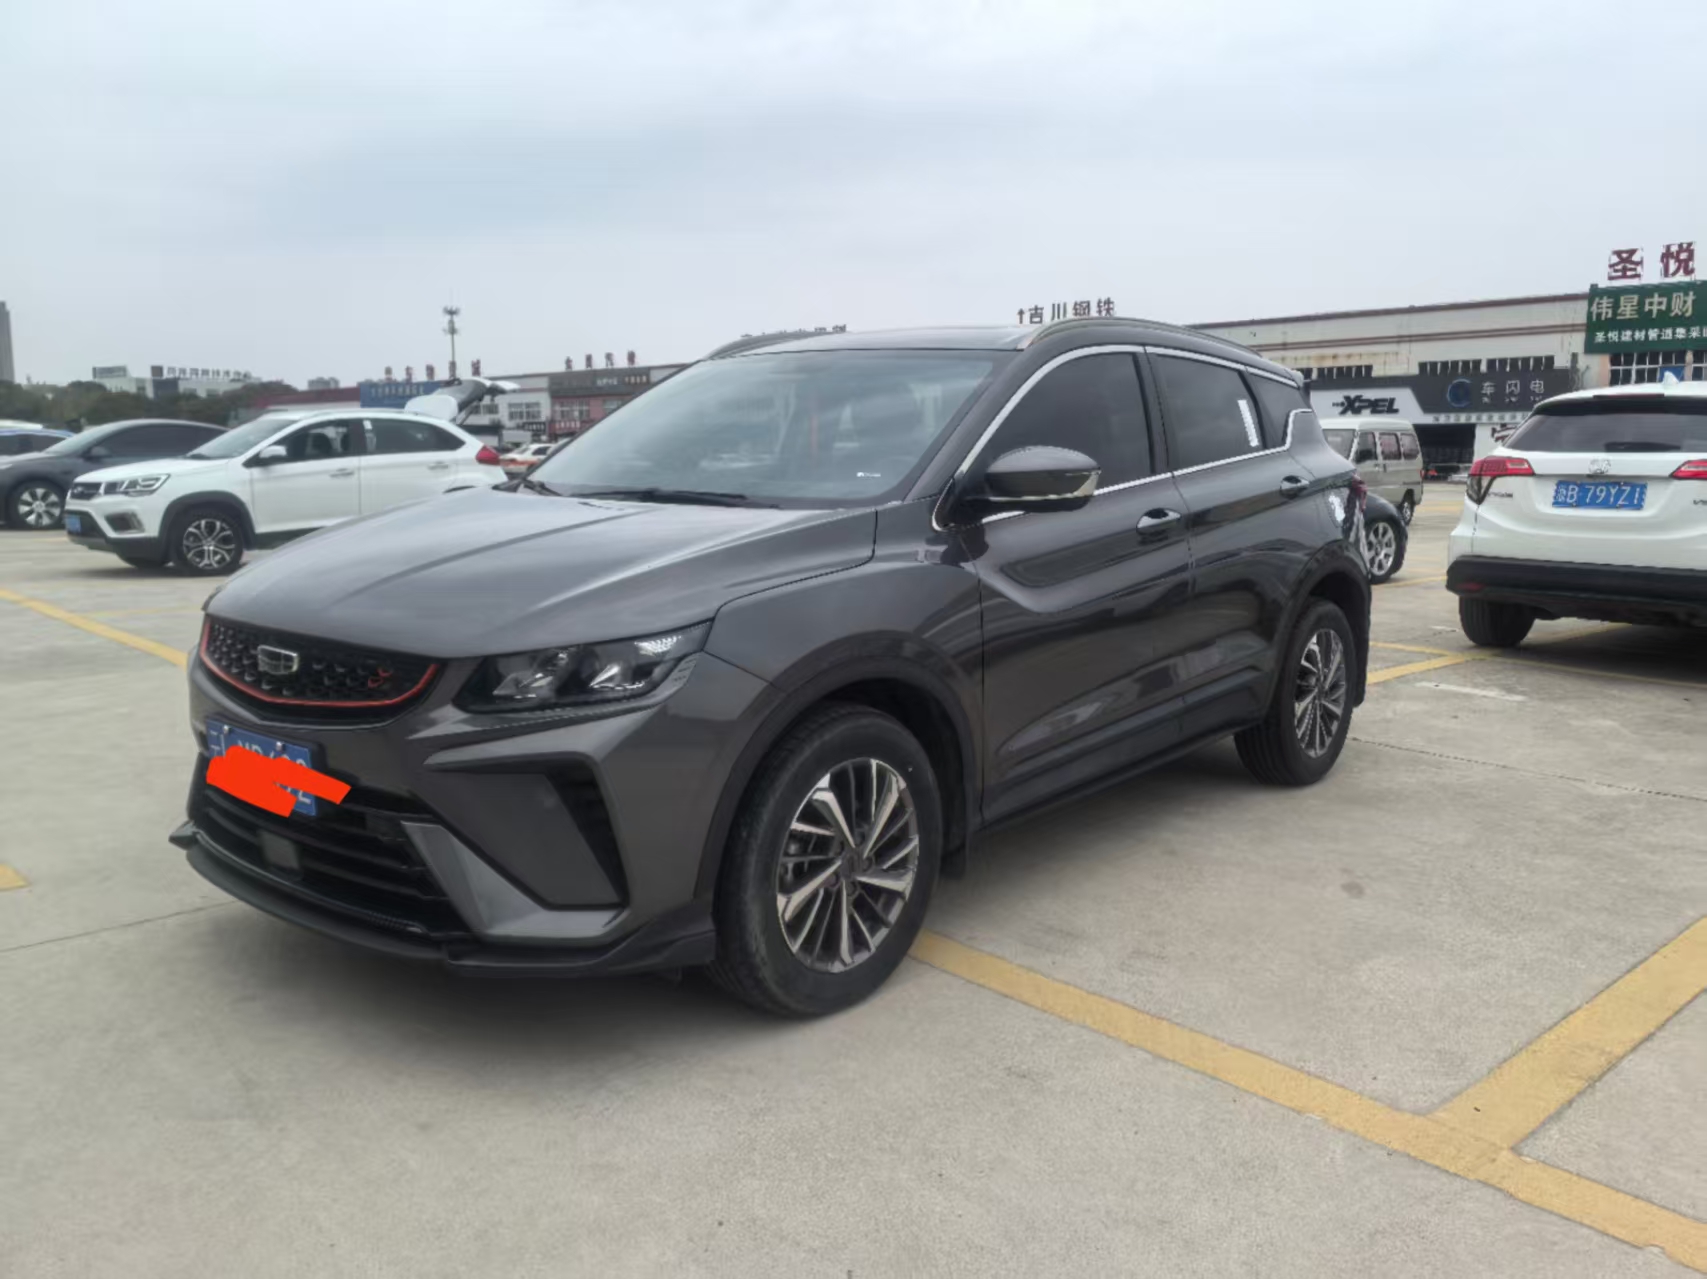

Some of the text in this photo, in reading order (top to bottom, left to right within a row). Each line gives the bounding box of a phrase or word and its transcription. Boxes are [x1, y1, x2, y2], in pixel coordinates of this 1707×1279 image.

[1607, 241, 1696, 281] 圣悦
[1590, 291, 1696, 321] 伟星中财
[1481, 379, 1545, 396] 车闪电
[1338, 394, 1400, 416] XPEL
